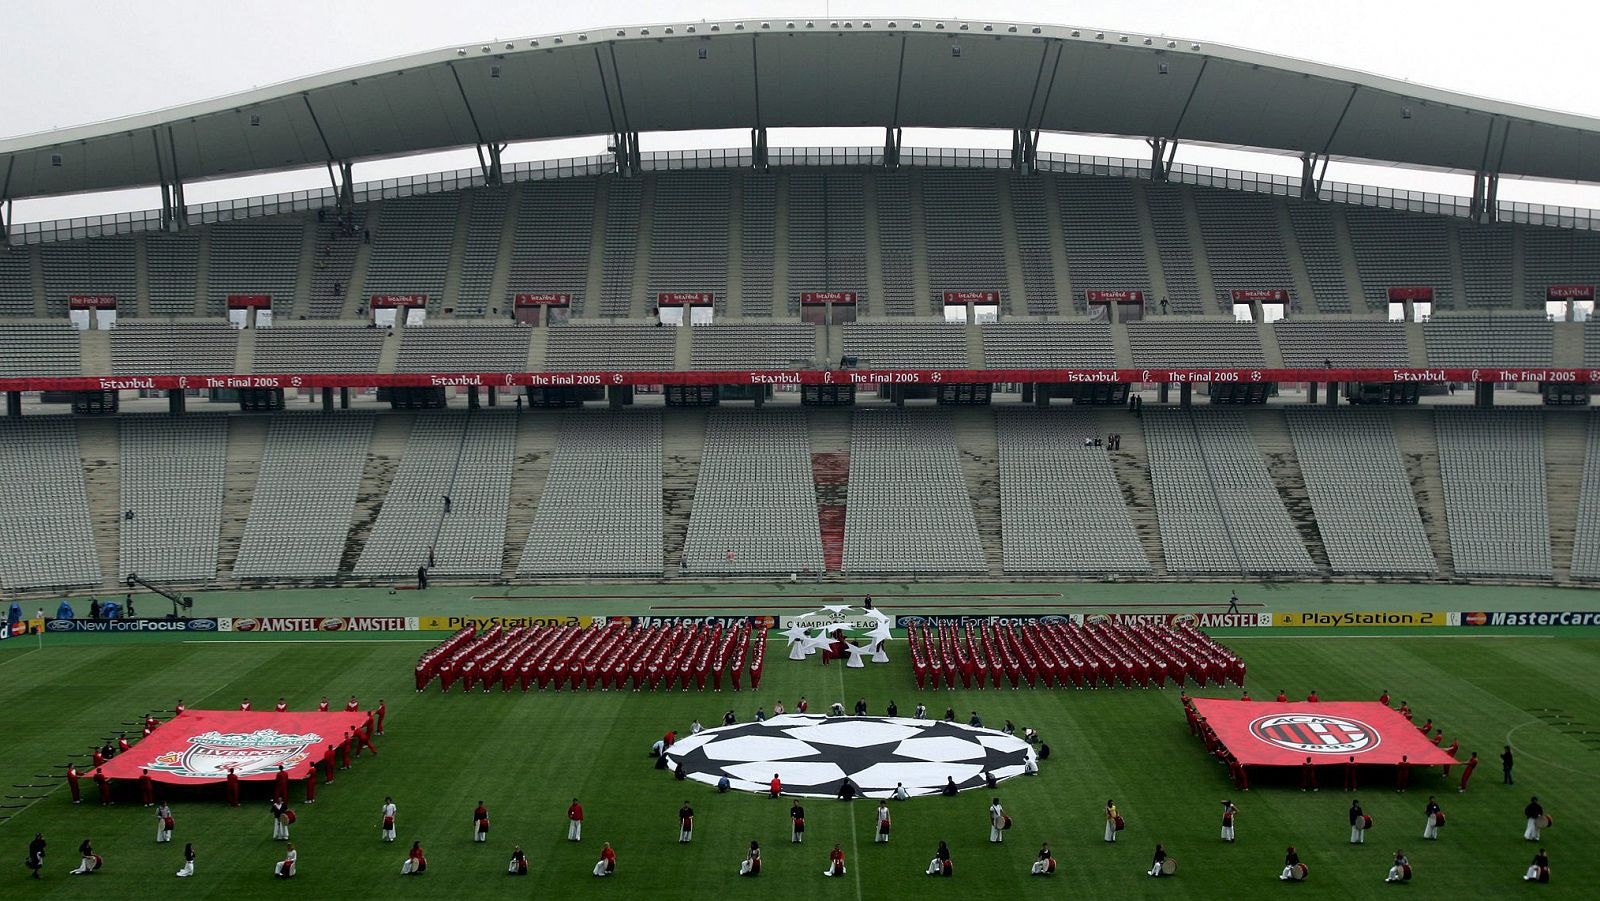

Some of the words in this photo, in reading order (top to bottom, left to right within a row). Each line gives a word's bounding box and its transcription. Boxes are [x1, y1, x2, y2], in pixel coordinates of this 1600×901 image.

[531, 375, 549, 385] The
[552, 375, 574, 385] Final
[577, 375, 601, 385] 2005
[850, 373, 867, 382] The
[870, 373, 892, 382] Final
[895, 373, 919, 382] 2005
[1169, 372, 1186, 381] The
[1189, 372, 1212, 381] Final
[1215, 372, 1239, 381] 2005
[1500, 371, 1517, 381] The
[1521, 371, 1546, 381] Final
[1550, 371, 1576, 381] 2005
[207, 378, 225, 387] The
[228, 378, 251, 387] Final
[254, 377, 279, 387] 2005
[261, 618, 318, 631] AMSTEL
[348, 617, 404, 631] AMSTEL
[449, 617, 559, 630] PlayStation
[566, 617, 580, 628] 2
[928, 616, 958, 627] New
[1200, 613, 1258, 627] AMSTEL
[1302, 612, 1413, 626] PlayStation
[1420, 612, 1434, 624] 2
[76, 620, 107, 631] New
[197, 748, 293, 756] LIVERPOOL
